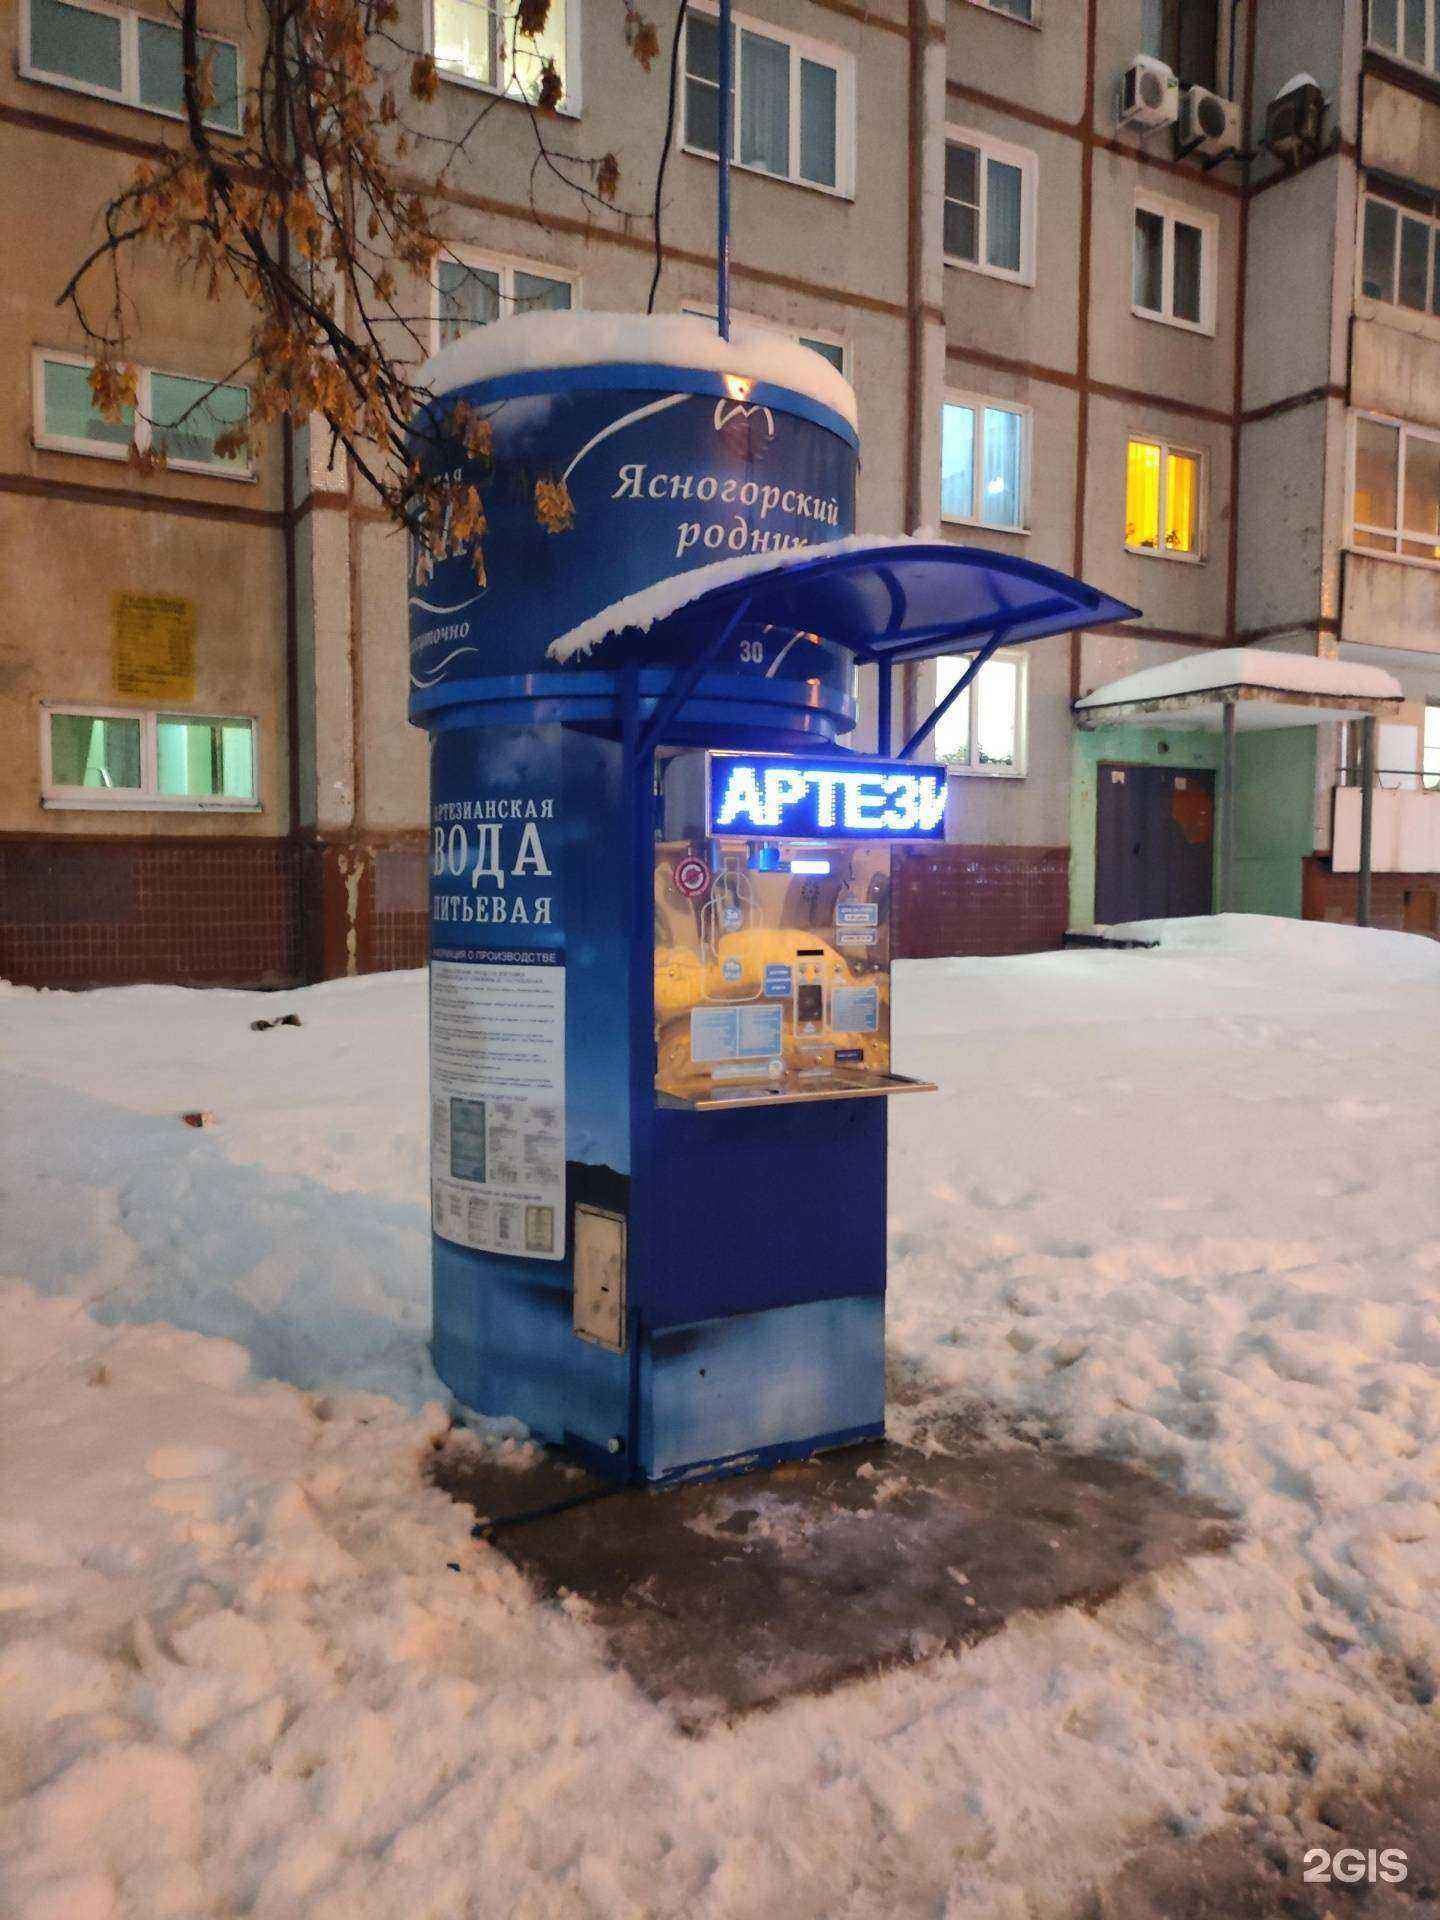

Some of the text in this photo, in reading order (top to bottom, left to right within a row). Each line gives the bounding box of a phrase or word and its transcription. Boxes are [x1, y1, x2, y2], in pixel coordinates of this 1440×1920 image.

[611, 463, 839, 527] Ясногорский
[739, 641, 764, 664] 30
[716, 766, 949, 831] АРТЕЗИ
[433, 822, 552, 889] ВОДА
[433, 896, 552, 924] ПИТЬЕВАЯ
[474, 950, 557, 963] ПРОИЗВОДСТВЕ
